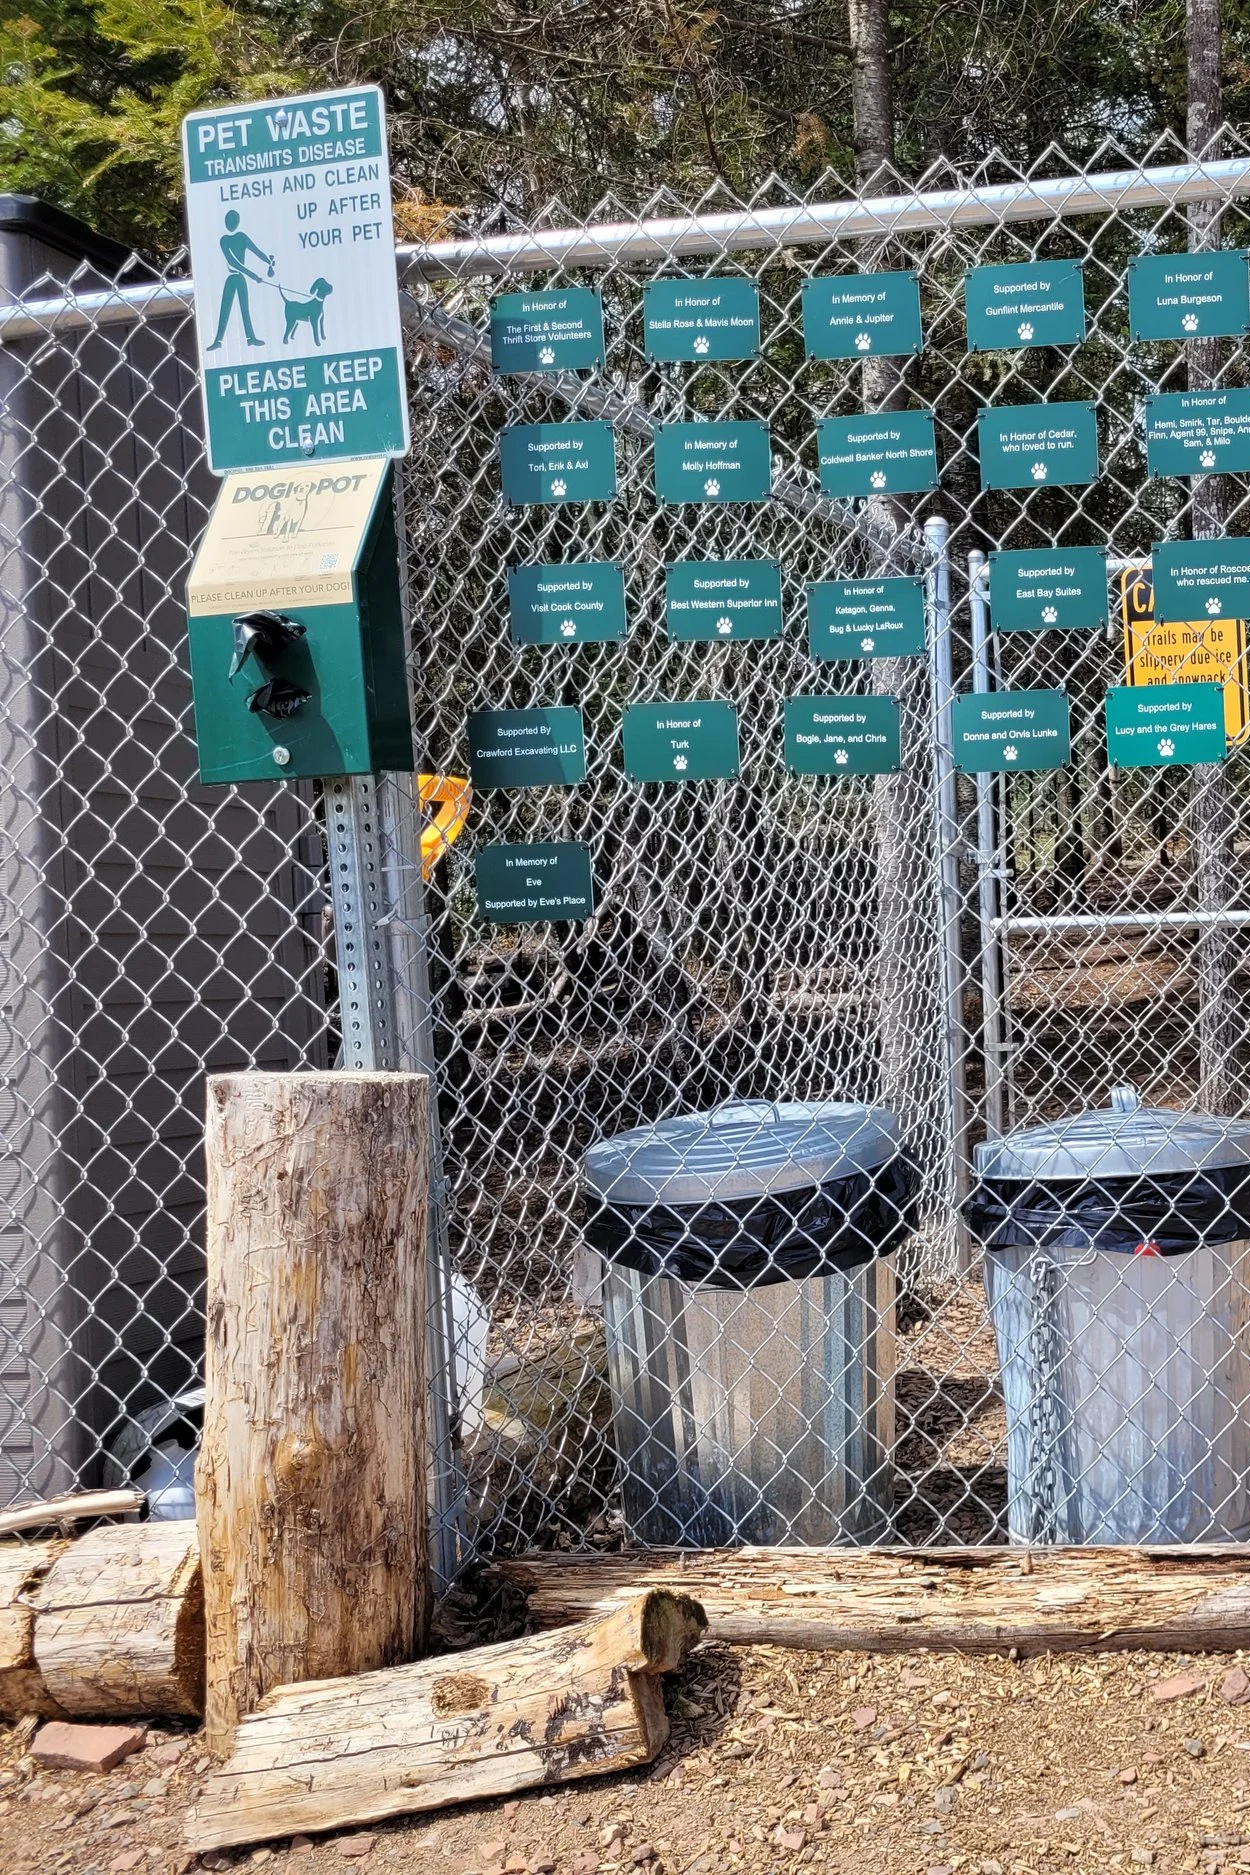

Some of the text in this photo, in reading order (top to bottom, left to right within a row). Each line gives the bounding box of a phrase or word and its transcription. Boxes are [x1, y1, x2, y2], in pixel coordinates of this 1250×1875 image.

[198, 100, 368, 153] PET WASTE
[204, 137, 366, 177] TRANSMITS DISEASE
[220, 163, 379, 202] LEASH AND CLEAN
[296, 193, 381, 220] UP AFTER
[298, 222, 383, 249] YOUR PET
[1156, 294, 1222, 305] Luna Burgeson
[985, 301, 1064, 316] Gunflint Mercantile
[506, 319, 583, 333] The First & Second
[648, 317, 754, 329] Stella Rose & Mavis Moon
[829, 313, 894, 325] Annie & Jupiter
[502, 331, 592, 344] Thrift Store Volunteers
[219, 356, 383, 397] PLEASE KEEP
[240, 388, 368, 423] THIS AREA
[268, 420, 345, 450] CLEAN
[999, 428, 1077, 442] In Honor of Cedar,
[1001, 443, 1020, 452] who
[1021, 440, 1045, 451] loved
[1046, 440, 1056, 450] to
[820, 448, 933, 465] Coldwell Banker North Shore
[682, 460, 740, 472] Molly Hoffman
[191, 591, 222, 604] PLEASE
[224, 589, 254, 601] CLEAN
[255, 588, 268, 599] UP
[269, 586, 297, 597] AFTER
[299, 583, 324, 594] YOUR
[1016, 587, 1081, 598] East Bay Suites
[530, 601, 603, 612] Visit Cook County
[670, 598, 777, 609] Best Western Superior Inn
[1145, 630, 1177, 646] Trails
[1211, 628, 1224, 642] be
[1190, 648, 1210, 665] due
[1215, 649, 1231, 663] ice
[1115, 726, 1135, 736] Lucy
[1136, 724, 1152, 734] and
[1153, 724, 1167, 733] the
[1191, 721, 1217, 730] Hares
[476, 743, 577, 758] Crawford Excavating LLC
[670, 739, 689, 749] Turk
[484, 896, 586, 909] Supported by Eve's Place
